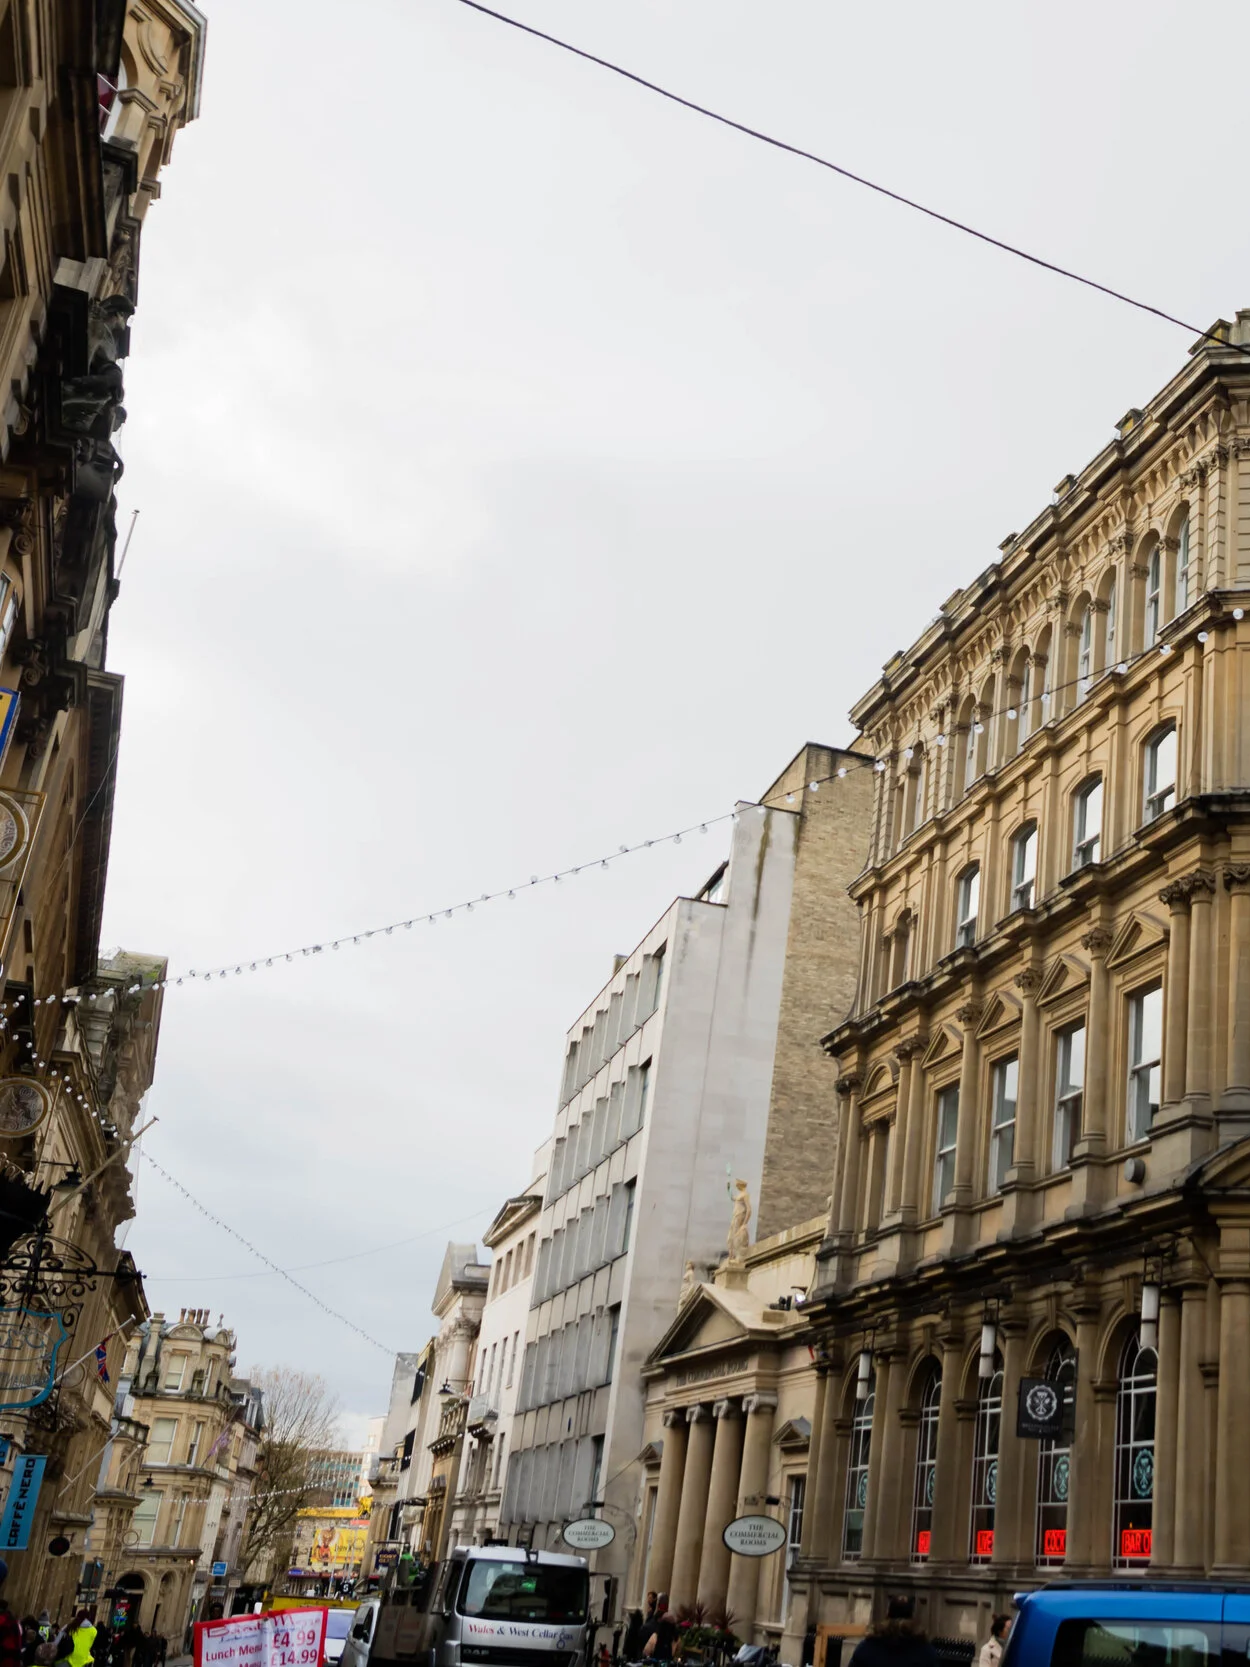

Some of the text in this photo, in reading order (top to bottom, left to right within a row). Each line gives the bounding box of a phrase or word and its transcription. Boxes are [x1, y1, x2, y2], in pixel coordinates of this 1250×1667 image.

[18, 1458, 37, 1499] NERO
[730, 1531, 779, 1539] COMMERCIAL
[749, 1523, 765, 1531] THE
[1124, 1533, 1142, 1552] BAR
[468, 1624, 495, 1635] Wales
[496, 1626, 505, 1636] &
[509, 1626, 529, 1637] West
[531, 1628, 558, 1640] Cellar
[205, 1647, 236, 1662] Lunch
[239, 1643, 263, 1656] Menu
[272, 1629, 316, 1649] £4.99
[271, 1648, 318, 1667] £14.99
